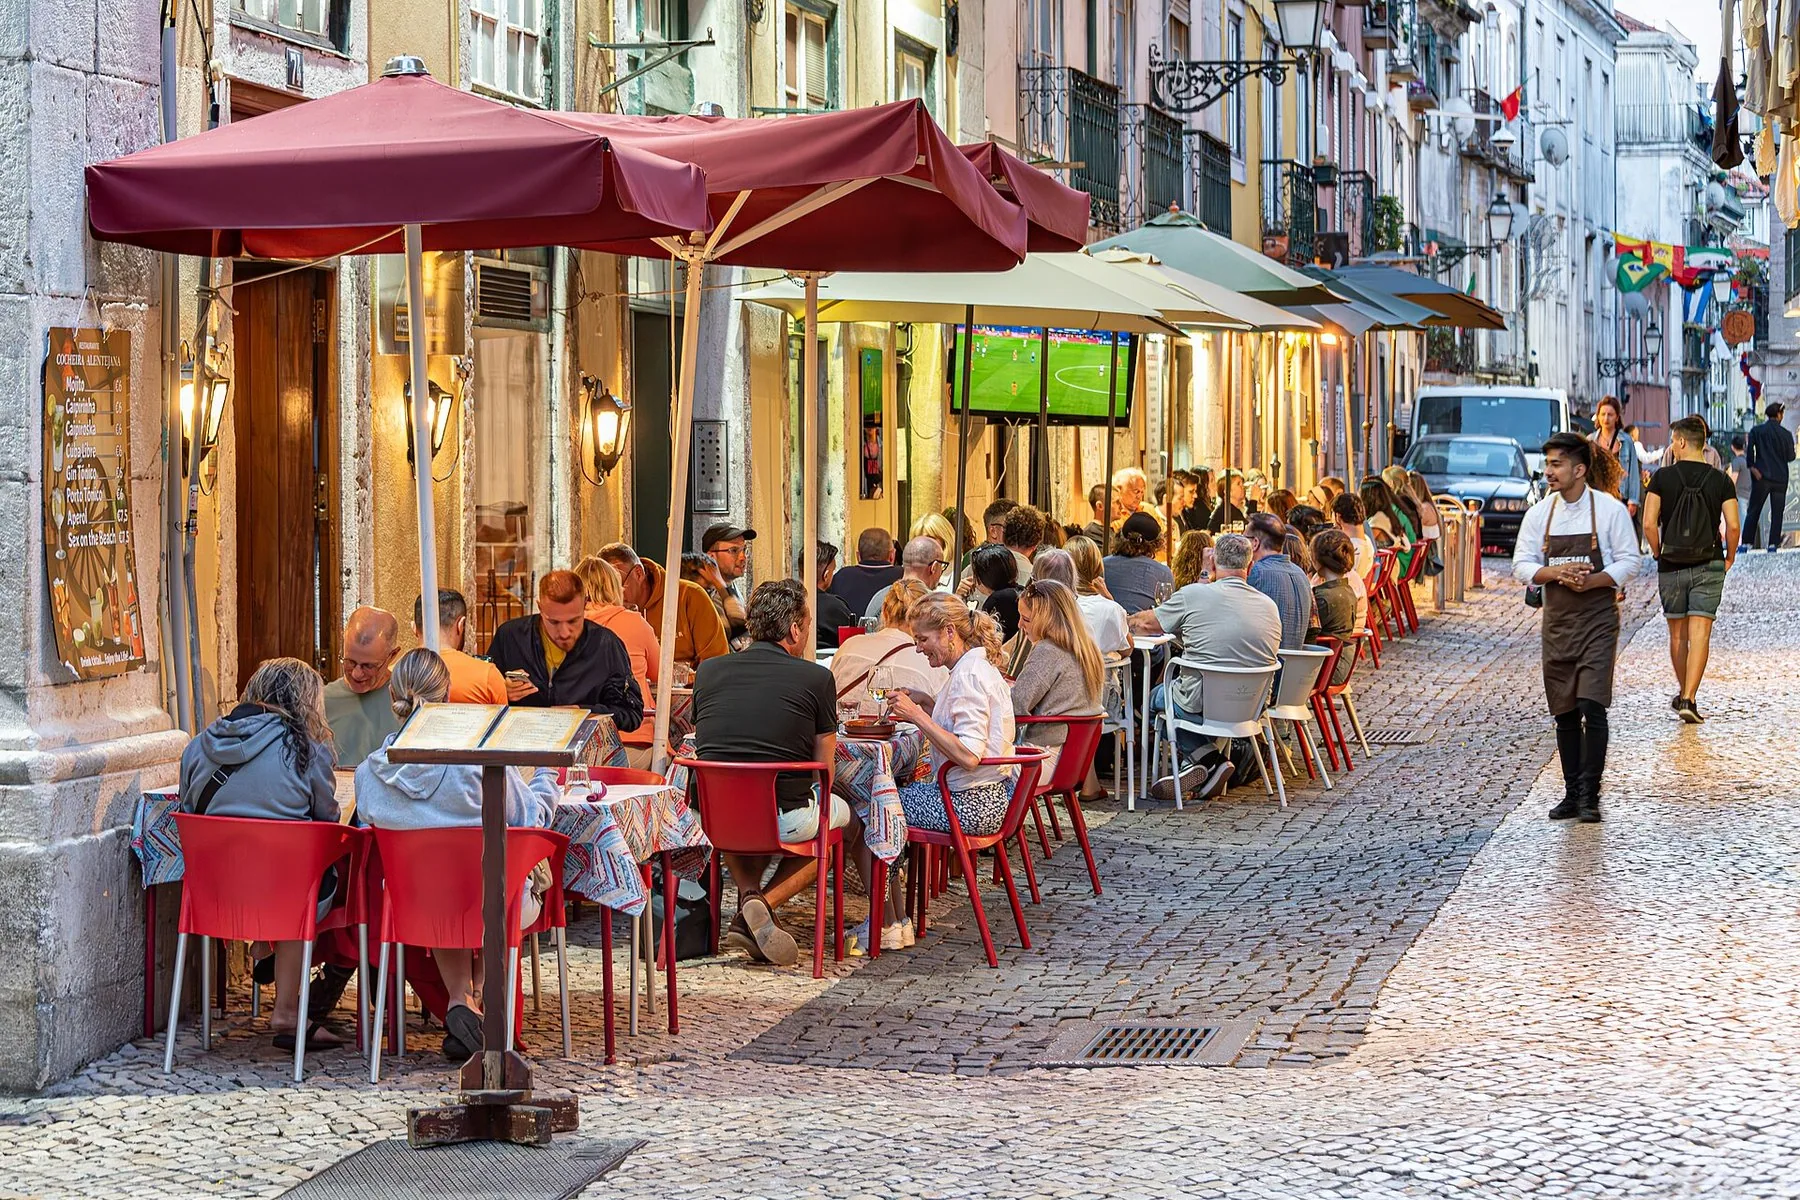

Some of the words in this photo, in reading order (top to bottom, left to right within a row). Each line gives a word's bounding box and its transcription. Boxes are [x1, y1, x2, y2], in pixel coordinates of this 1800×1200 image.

[56, 354, 85, 366] COCHEIRA
[87, 355, 121, 369] ALENTEJANA
[66, 376, 85, 396] Mojito
[66, 397, 95, 418] Caipirinha
[66, 420, 96, 439] Caipiroska
[66, 442, 80, 458] Cuba
[81, 441, 96, 458] Libre
[66, 464, 77, 481] Gin
[77, 463, 97, 480] Tónico
[67, 487, 83, 503] Porto
[83, 486, 103, 503] Tónico
[67, 508, 88, 529] Aperol
[69, 532, 80, 547] Sex
[80, 535, 88, 547] on
[88, 529, 98, 546] the
[98, 528, 116, 545] Beach
